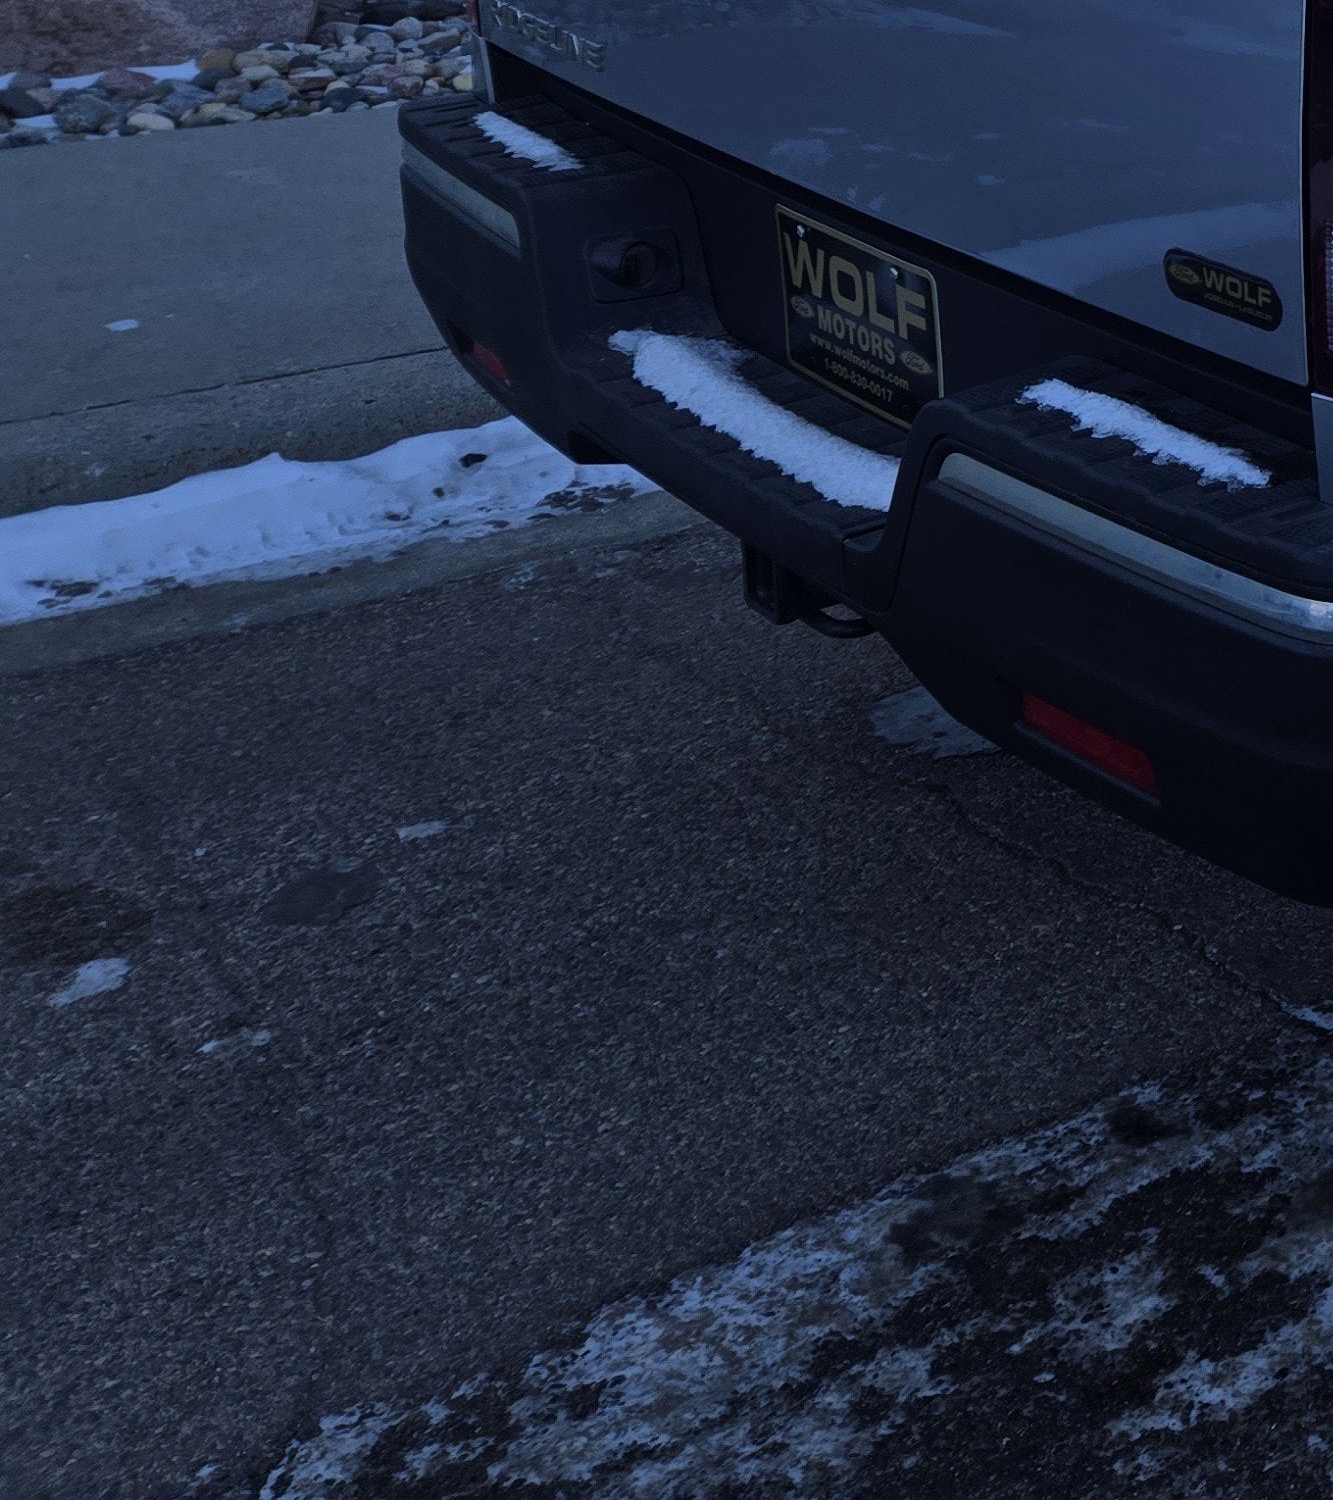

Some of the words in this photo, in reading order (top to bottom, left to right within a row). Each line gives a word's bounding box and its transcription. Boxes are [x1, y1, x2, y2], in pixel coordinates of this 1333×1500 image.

[784, 232, 927, 340] WOLF
[1202, 266, 1272, 308] WOLF
[810, 332, 909, 391] www.wolfmotors.com
[817, 305, 896, 365] MOTORS
